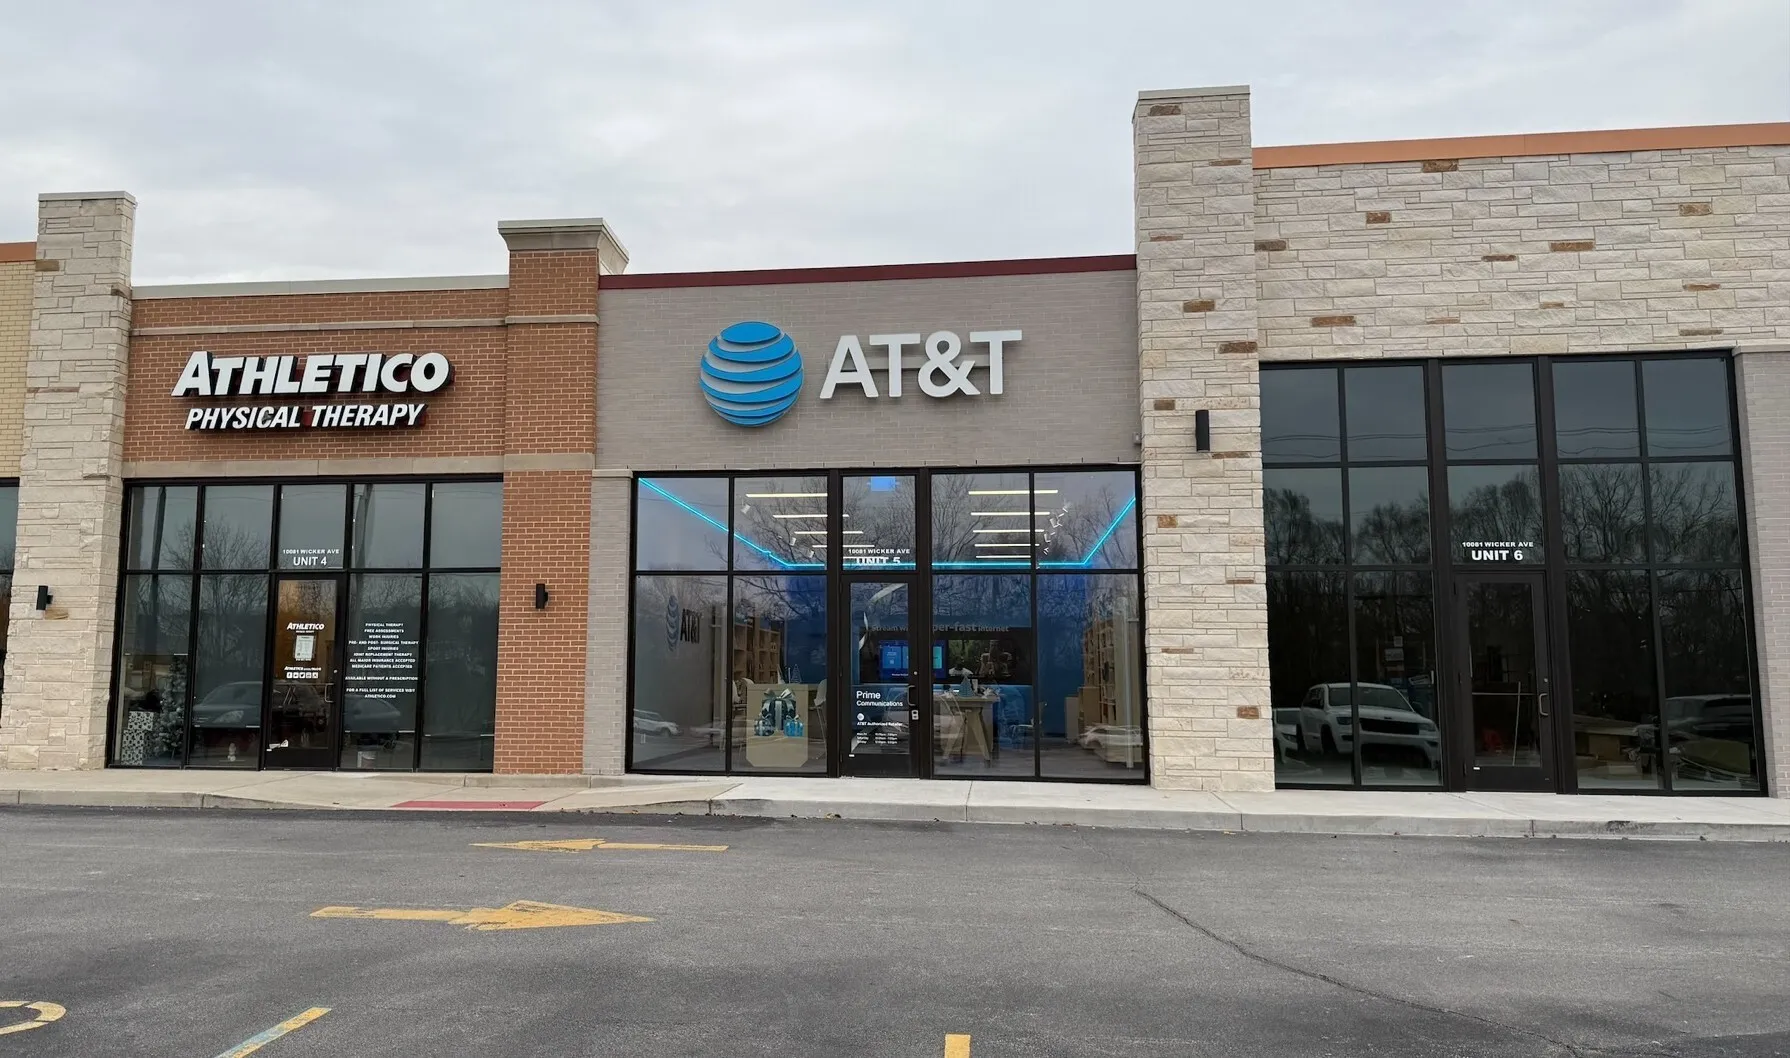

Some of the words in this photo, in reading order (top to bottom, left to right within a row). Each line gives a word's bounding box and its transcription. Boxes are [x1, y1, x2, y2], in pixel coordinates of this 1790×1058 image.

[819, 329, 1023, 399] AT&T
[171, 350, 450, 397] ATHLETICO
[185, 405, 301, 430] PHYSICAL
[310, 403, 425, 428] THERAPY
[1471, 549, 1510, 560] UNIT
[1513, 549, 1524, 561] 6
[293, 556, 319, 566] UNIT
[320, 556, 327, 566] 4
[856, 556, 889, 566] UNIT
[892, 556, 901, 566] 5
[286, 622, 325, 630] ATHLETICO
[856, 690, 881, 699] Prime
